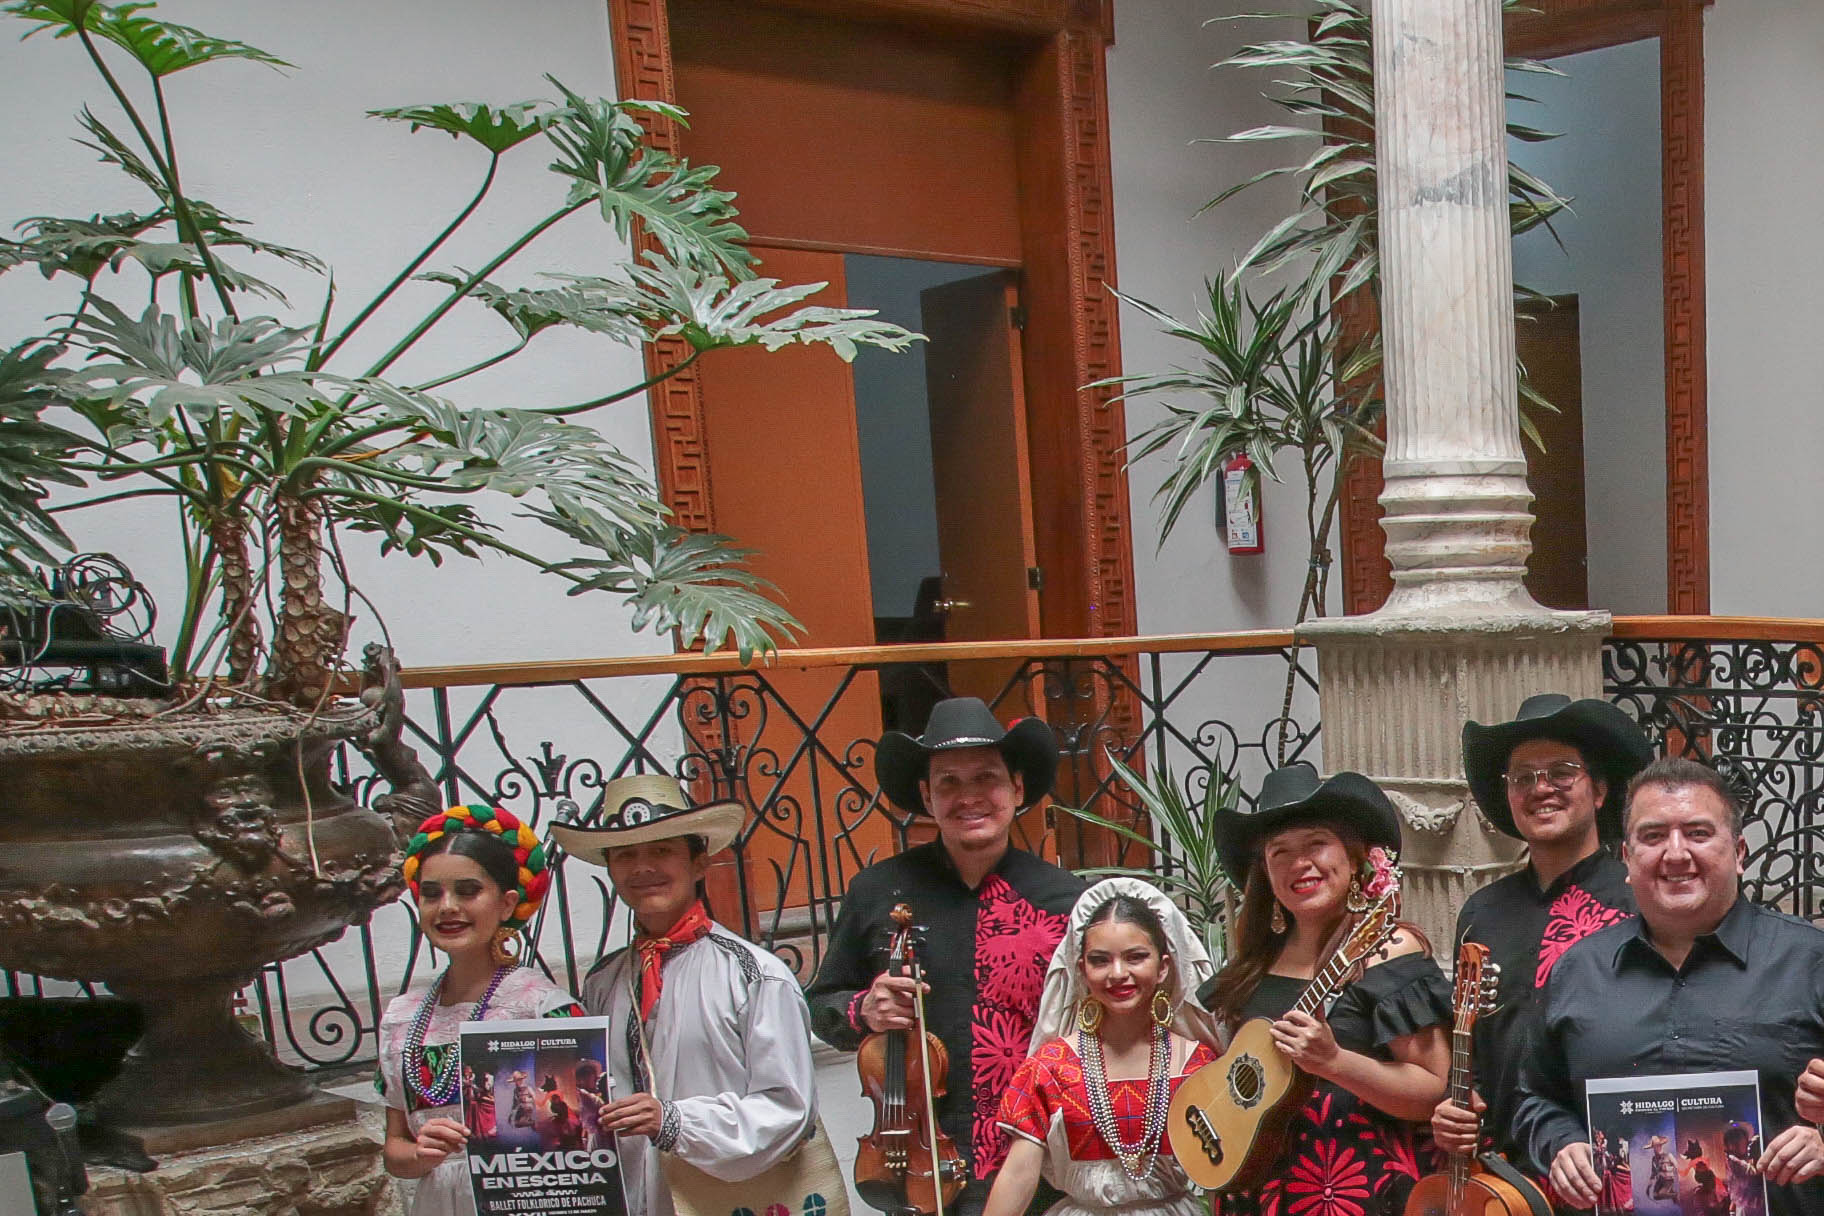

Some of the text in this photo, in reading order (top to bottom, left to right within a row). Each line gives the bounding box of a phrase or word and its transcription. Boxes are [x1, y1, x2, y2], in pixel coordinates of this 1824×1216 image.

[501, 1040, 536, 1048] HIDALGO
[541, 1038, 577, 1046] CULTURA
[1635, 1100, 1674, 1109] HIDALGO
[1681, 1097, 1723, 1106] CULTURA
[469, 1147, 617, 1174] MÉXICO
[482, 1172, 607, 1189] EN ESCENA
[561, 1197, 571, 1208] DE
